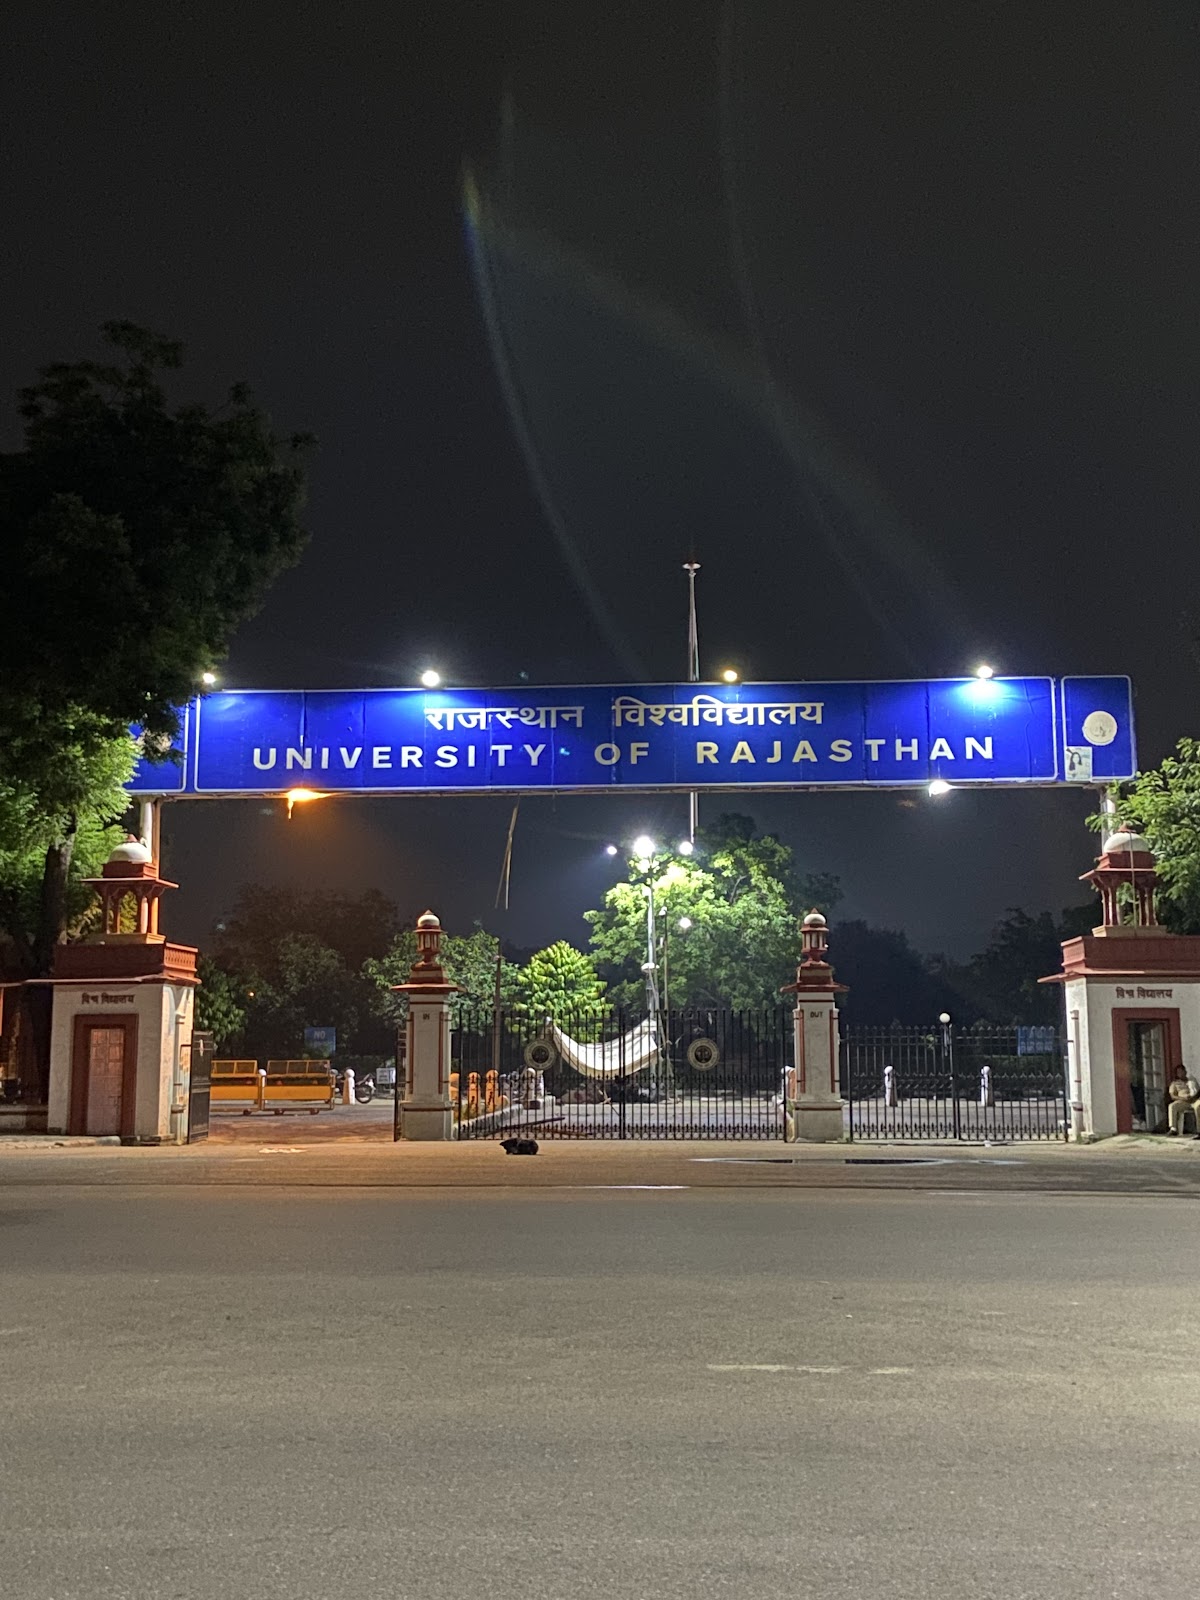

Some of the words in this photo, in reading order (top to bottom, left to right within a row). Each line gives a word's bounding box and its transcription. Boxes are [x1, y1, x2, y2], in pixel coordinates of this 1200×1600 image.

[424, 706, 584, 730] राजस्थान
[612, 695, 824, 726] विश्वविद्यालय
[252, 744, 546, 770] UNIVERSITY
[594, 742, 649, 766] OF
[696, 736, 993, 764] RAJASTHAN
[313, 1030, 326, 1039] NO
